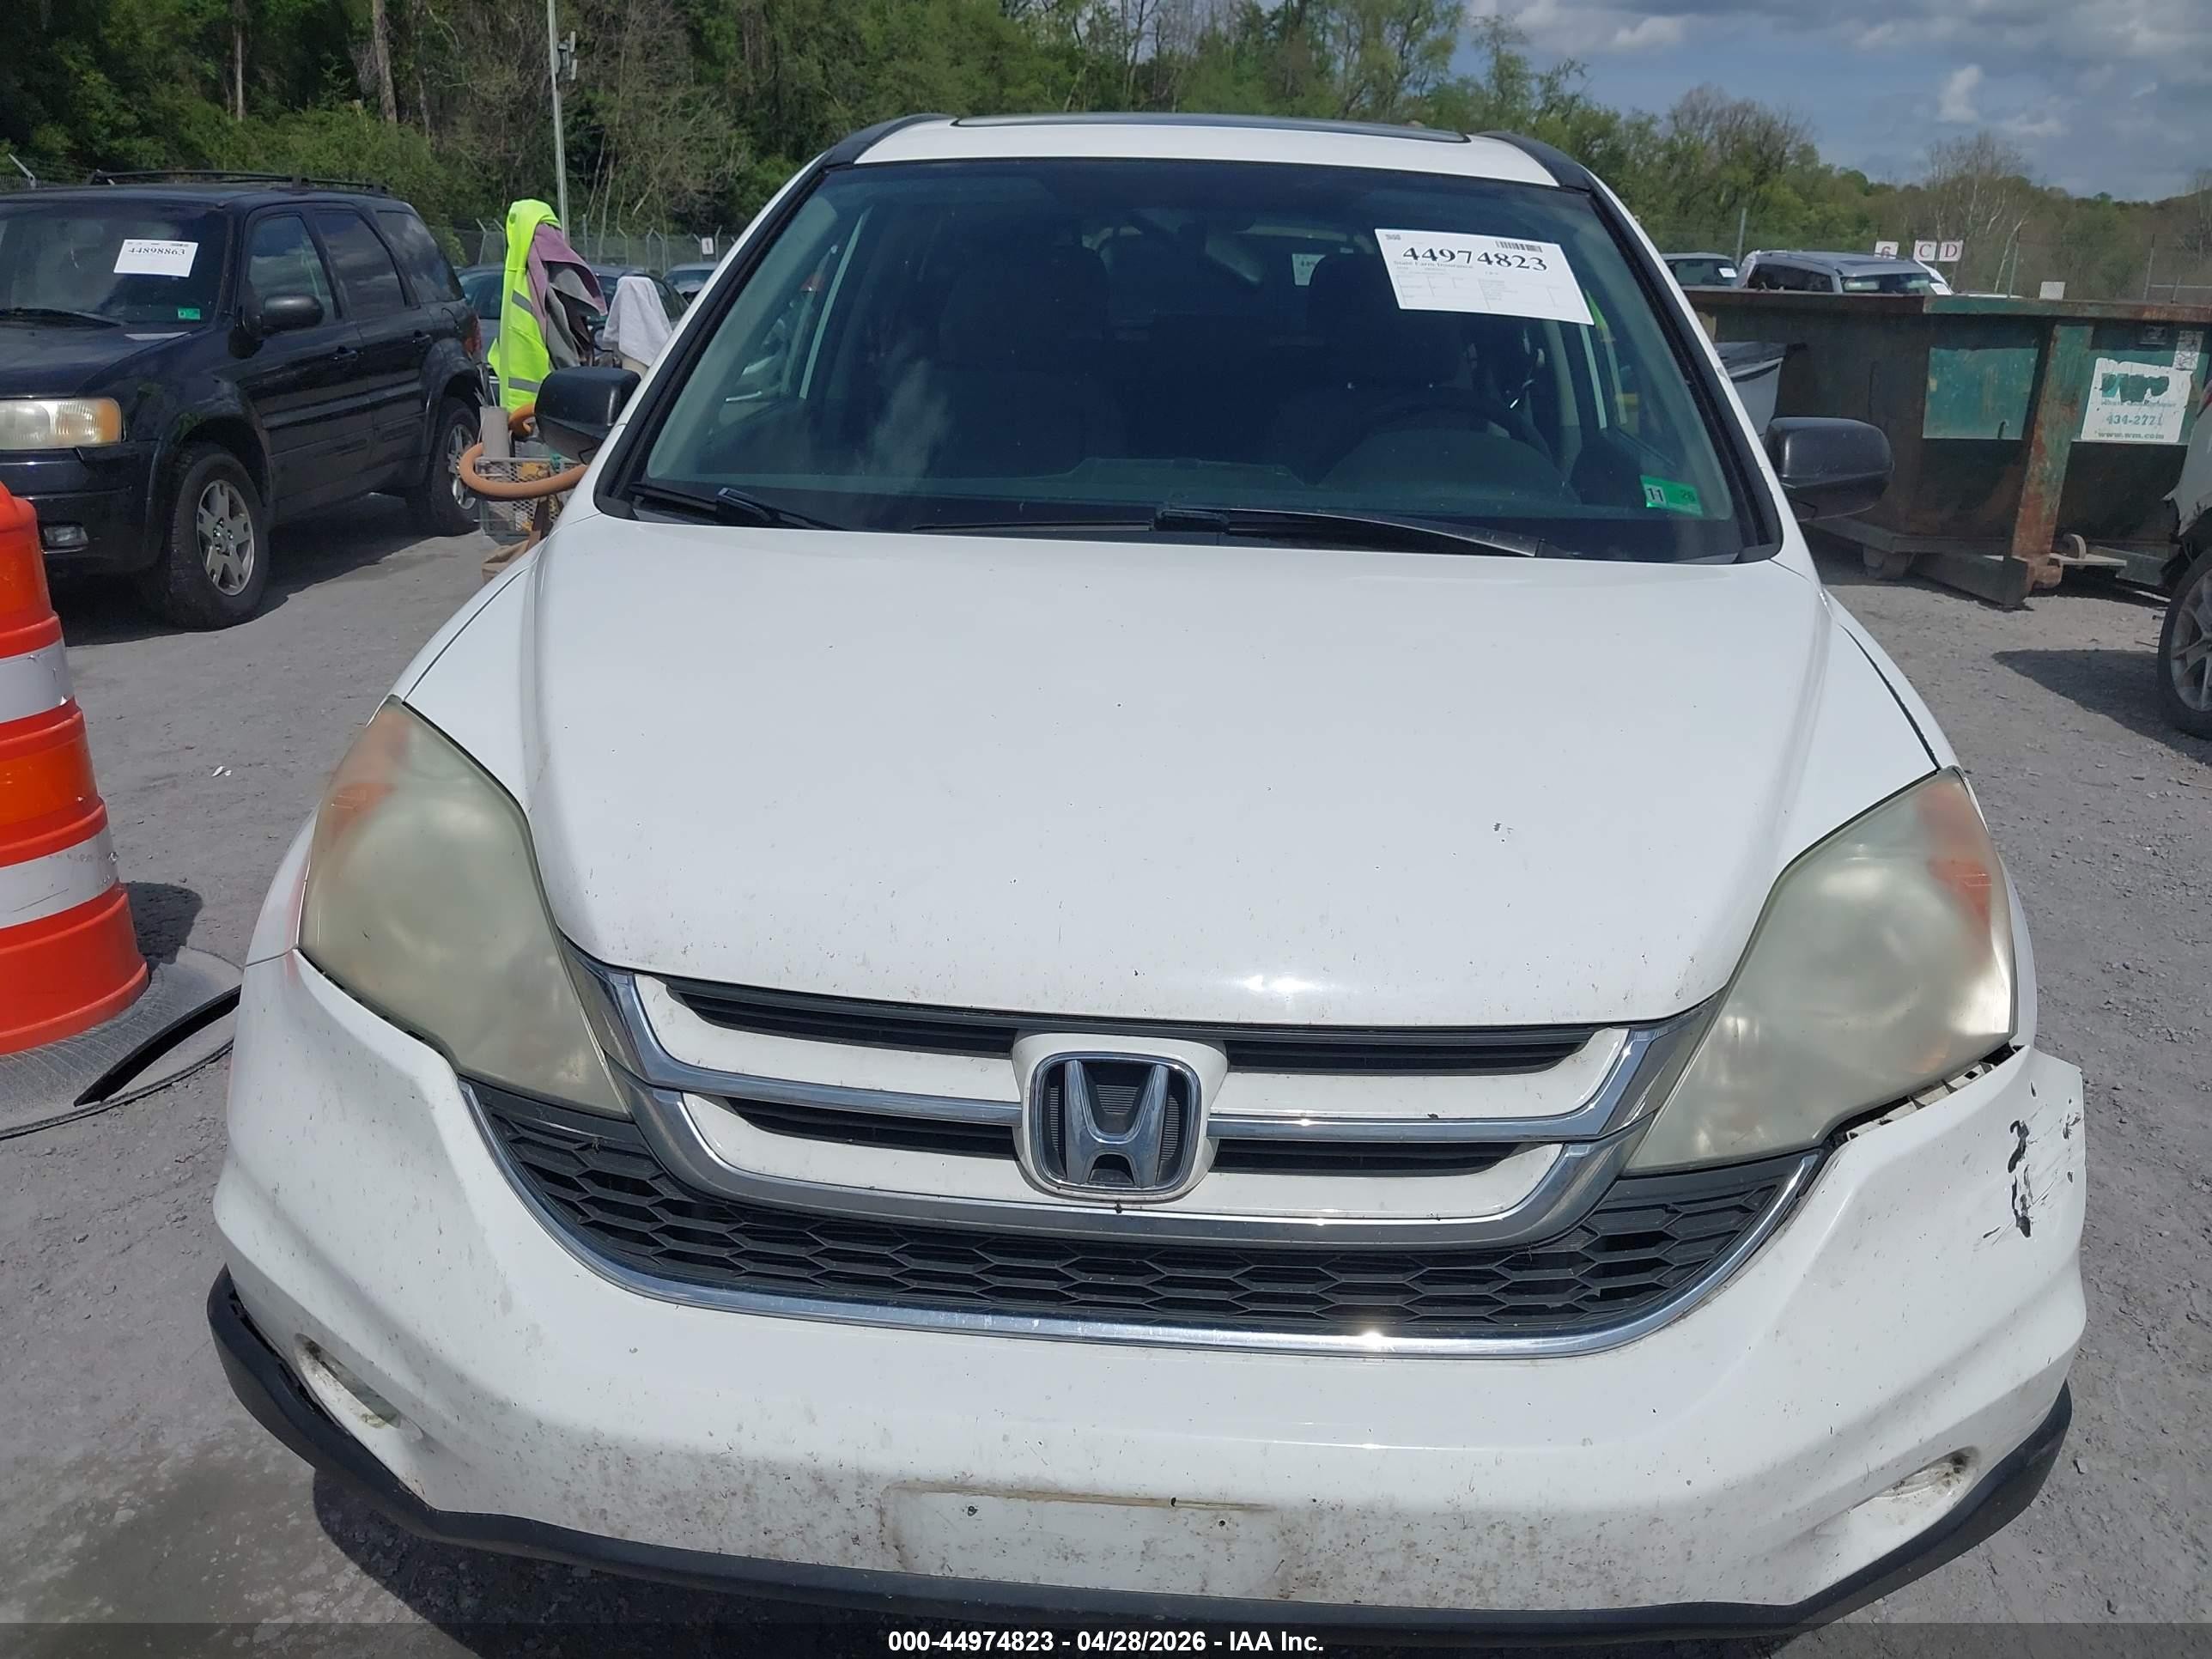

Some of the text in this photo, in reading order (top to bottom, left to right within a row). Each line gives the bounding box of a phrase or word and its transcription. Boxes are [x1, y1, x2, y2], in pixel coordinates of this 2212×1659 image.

[1918, 244, 1932, 258] C
[1944, 244, 1958, 258] D
[1402, 246, 1547, 271] 44974823
[1647, 487, 1663, 501] 11
